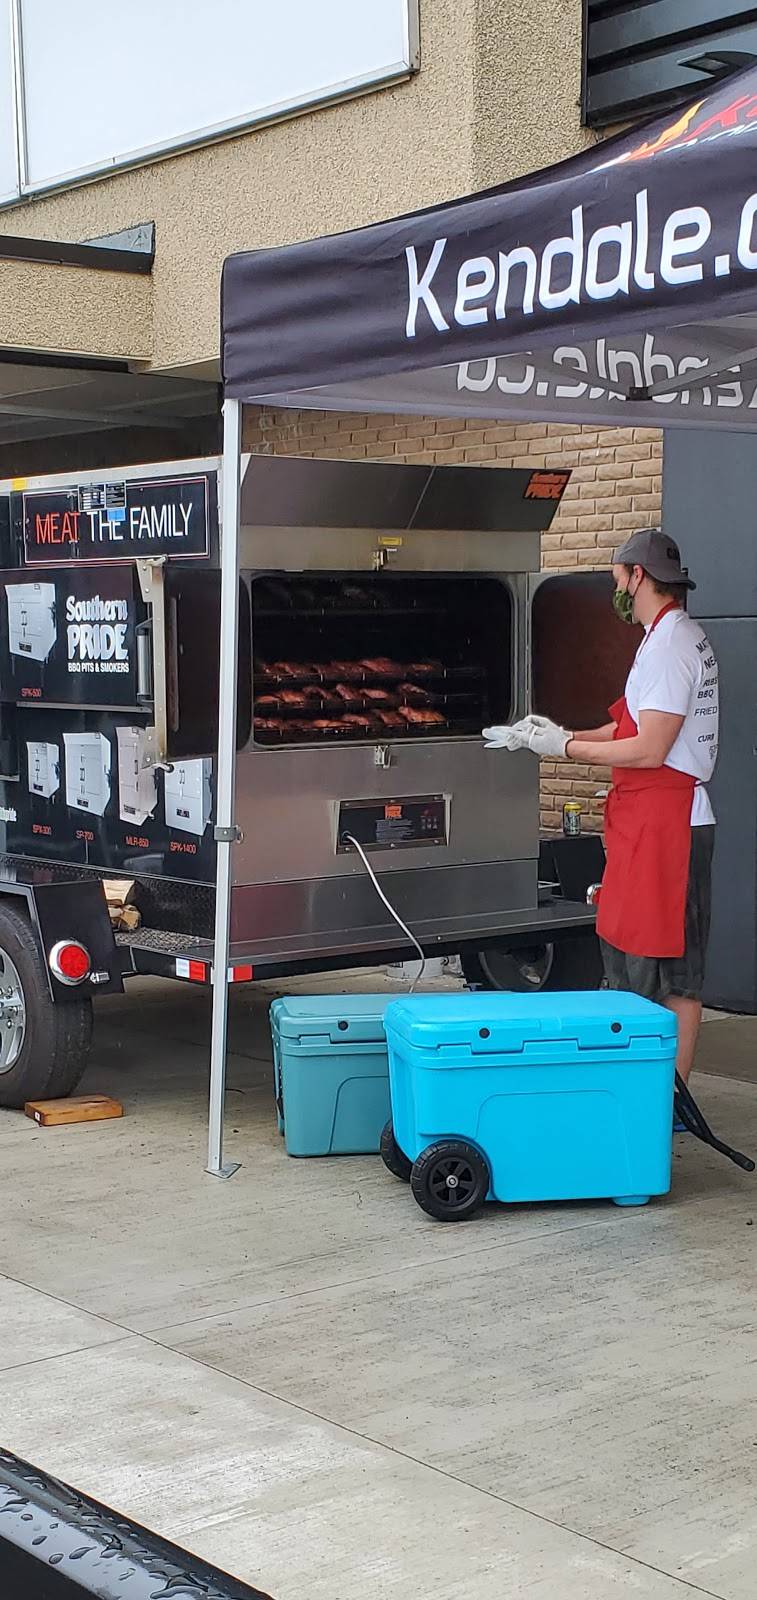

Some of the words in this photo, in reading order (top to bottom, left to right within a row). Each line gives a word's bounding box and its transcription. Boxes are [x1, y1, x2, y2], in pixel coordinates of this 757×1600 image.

[35, 511, 81, 545] MEAT
[86, 510, 124, 543] THE
[129, 502, 194, 540] FAMILY
[66, 594, 128, 622] Southern
[66, 623, 128, 660] PRIDE
[68, 662, 81, 673] BBQ
[81, 662, 94, 673] PITS
[100, 662, 130, 673] SMOKERS
[697, 689, 714, 699] BBQ
[694, 705, 718, 716] FRIED
